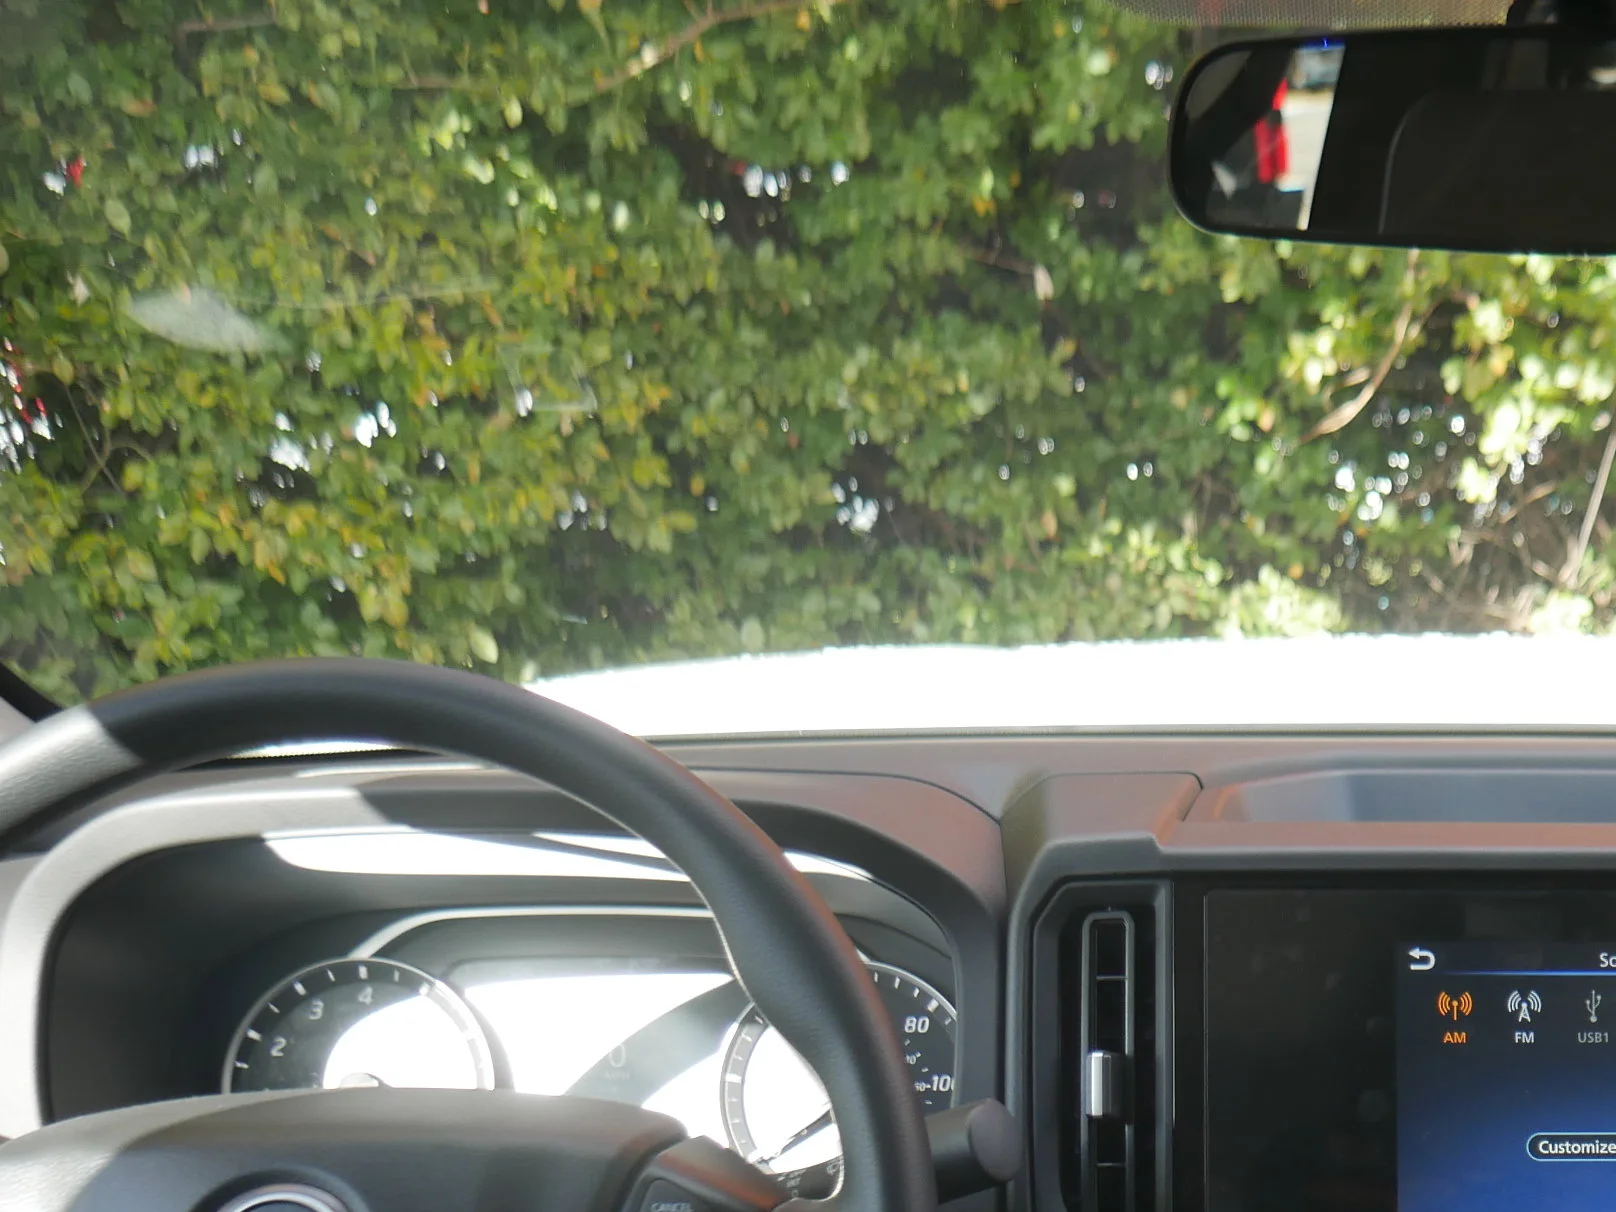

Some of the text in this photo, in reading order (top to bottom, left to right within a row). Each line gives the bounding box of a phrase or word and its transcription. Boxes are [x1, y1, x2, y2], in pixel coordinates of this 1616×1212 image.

[357, 986, 373, 1005] 4
[308, 999, 324, 1020] 3
[904, 1015, 930, 1034] 80
[1443, 1032, 1467, 1044] AM
[1514, 1032, 1535, 1044] FM
[1577, 1031, 1609, 1044] USB1
[270, 1036, 287, 1057] 2
[931, 1073, 954, 1092] 10
[1538, 1140, 1616, 1154] Customize
[651, 1202, 694, 1212] CANCEL
